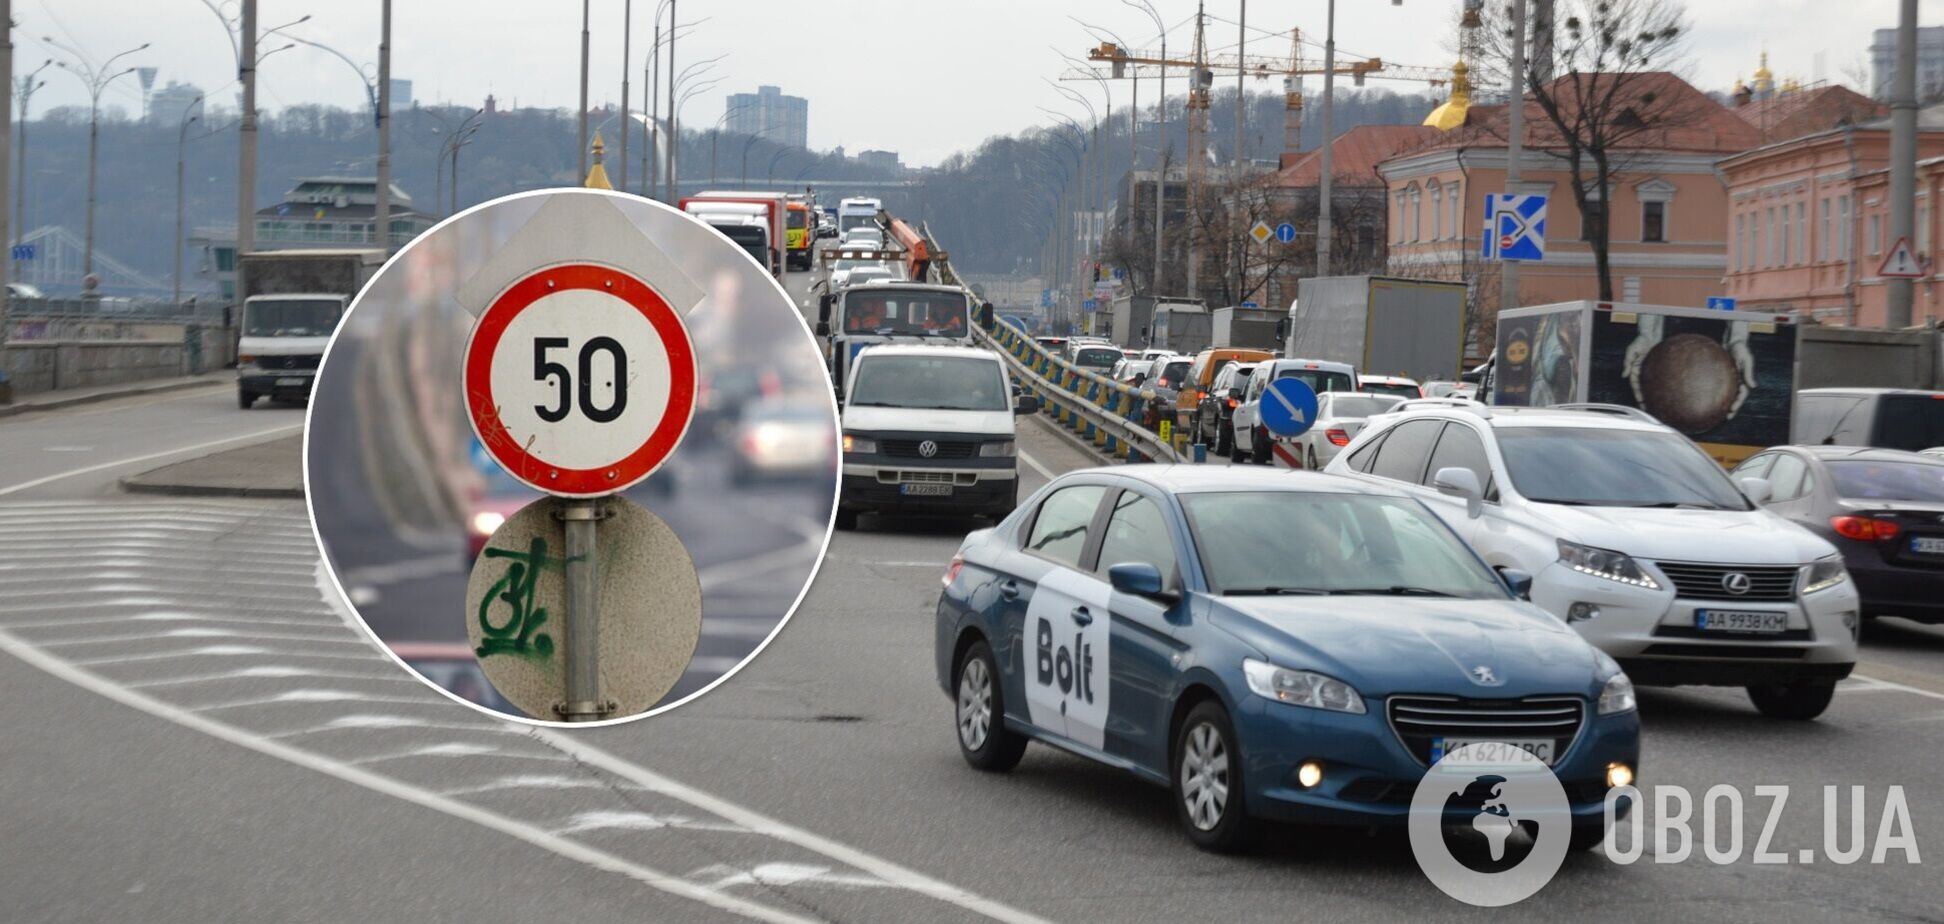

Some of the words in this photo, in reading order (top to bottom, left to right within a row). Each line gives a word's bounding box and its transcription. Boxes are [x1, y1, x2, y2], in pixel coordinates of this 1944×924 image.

[534, 336, 627, 423] 50
[1707, 612, 1726, 628] AA
[1729, 613, 1761, 629] 9938
[1763, 615, 1784, 630] KM
[1037, 617, 1094, 713] Bolt
[1444, 742, 1470, 761] KA
[1475, 742, 1518, 762] 6217
[1522, 743, 1548, 762] BC
